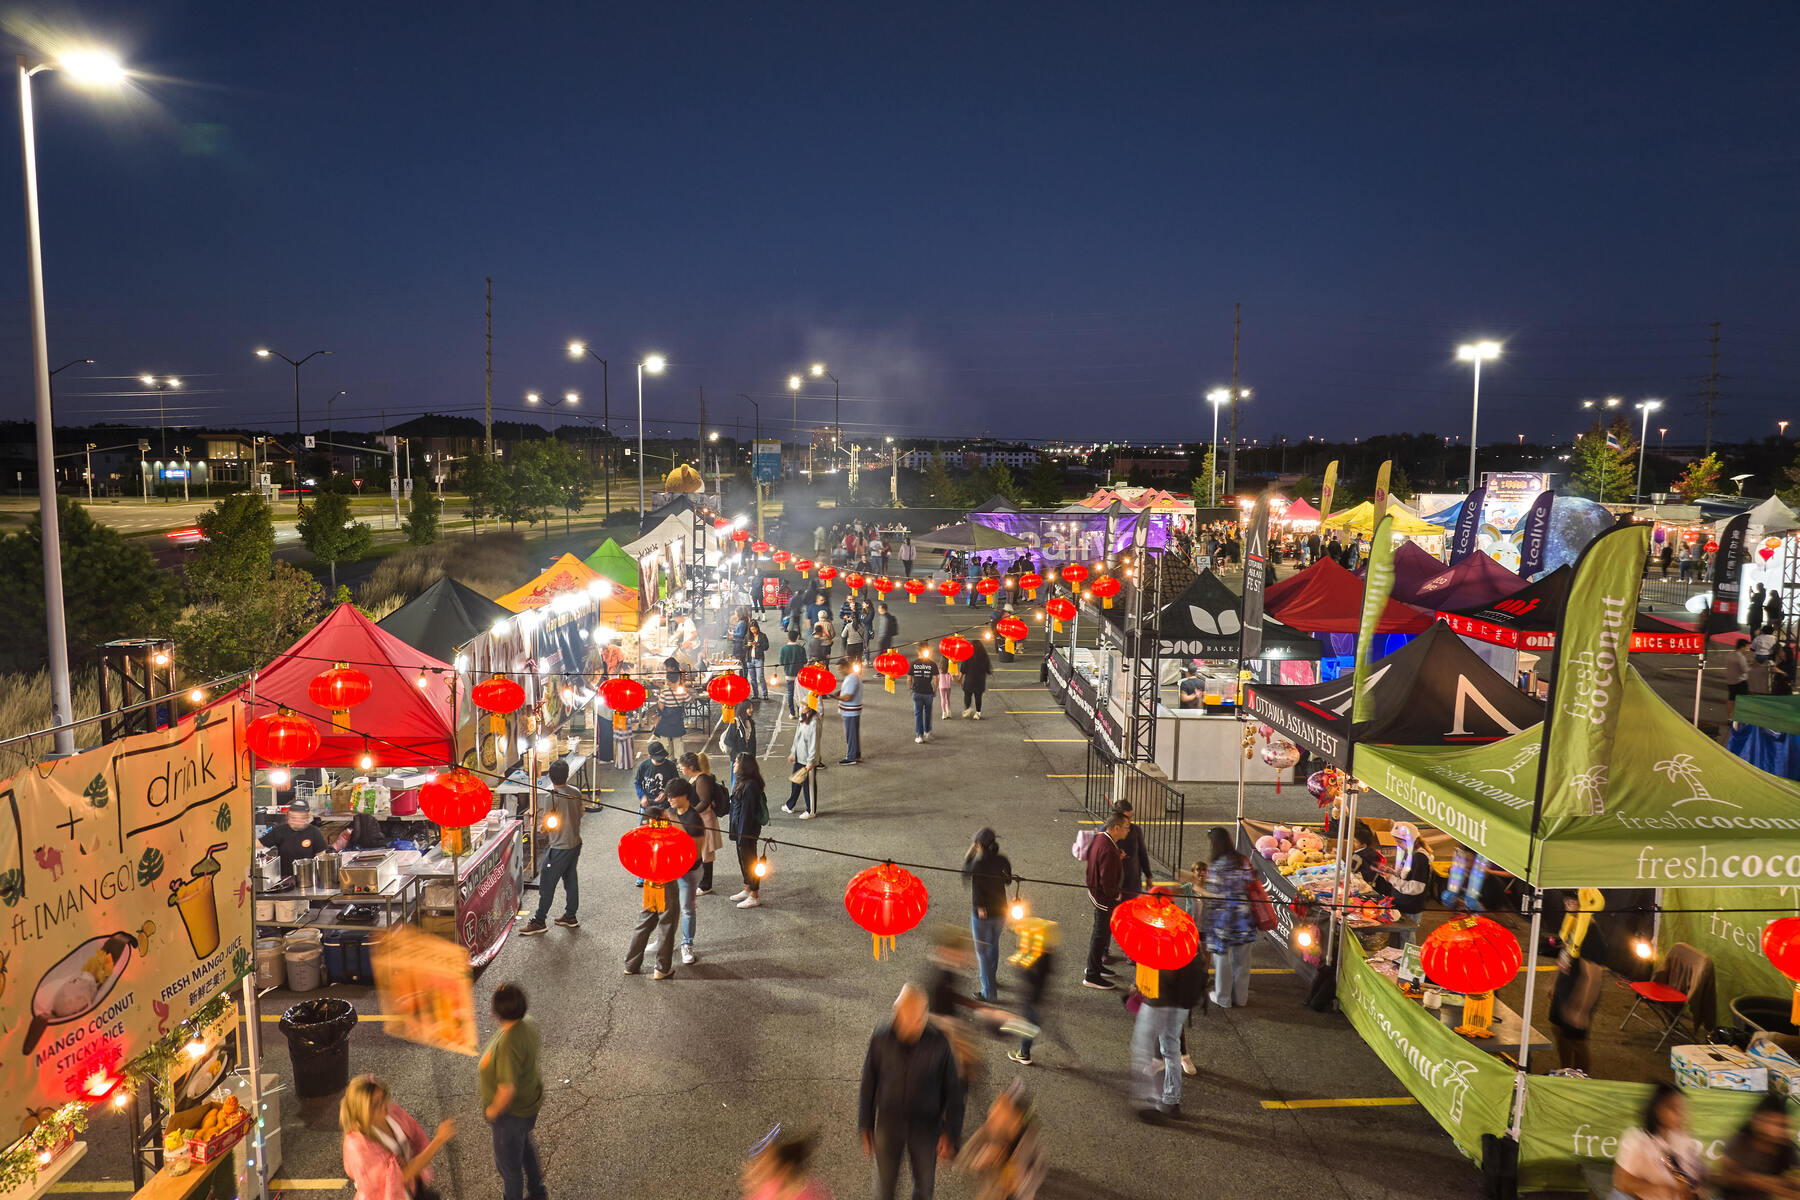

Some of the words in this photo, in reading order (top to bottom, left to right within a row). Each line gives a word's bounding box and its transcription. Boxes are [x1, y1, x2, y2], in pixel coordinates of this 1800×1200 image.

[1457, 501, 1477, 555] tealive
[1527, 507, 1546, 567] tealive
[1246, 577, 1262, 593] FEST
[1247, 568, 1262, 580] ASIAN
[913, 663, 932, 671] tealive
[1206, 645, 1240, 653] BAKE
[1588, 594, 1626, 725] coconut
[1635, 637, 1663, 649] RICE
[1669, 637, 1699, 649] BALL
[1563, 650, 1594, 719] fresh
[1255, 695, 1285, 727] OTTAWA
[1286, 713, 1315, 744] ASIAN
[1315, 729, 1338, 758] FEST
[147, 743, 216, 807] drink
[1424, 764, 1535, 810] freshcoconut
[1384, 765, 1488, 847] freshcoconut
[1276, 922, 1290, 940] FEST
[161, 974, 191, 1003] FRESH
[191, 951, 225, 982] MANGO
[225, 935, 242, 959] JUICE
[35, 1027, 85, 1068] MANGO
[88, 991, 134, 1034] COCONUT
[56, 1040, 98, 1074] STICKY
[102, 1021, 125, 1045] RICE
